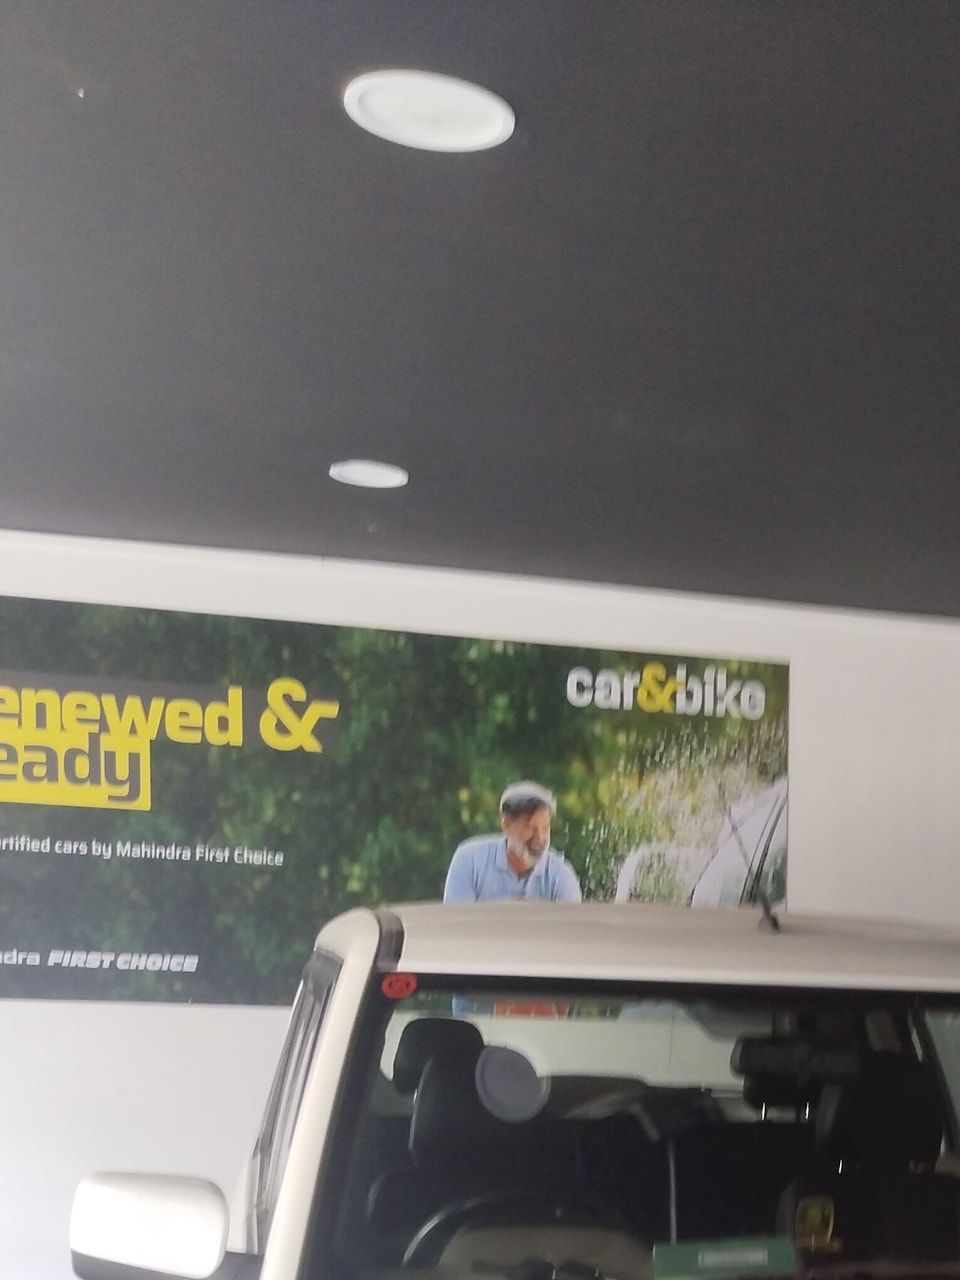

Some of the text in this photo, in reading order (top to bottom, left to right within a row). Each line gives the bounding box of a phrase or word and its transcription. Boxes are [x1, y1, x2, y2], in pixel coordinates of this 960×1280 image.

[566, 661, 766, 721] car&bike
[259, 677, 341, 753] &
[0, 834, 285, 867] rtified cars by Mahindra First Choice
[0, 948, 200, 973] dra FIRST CHOICE
